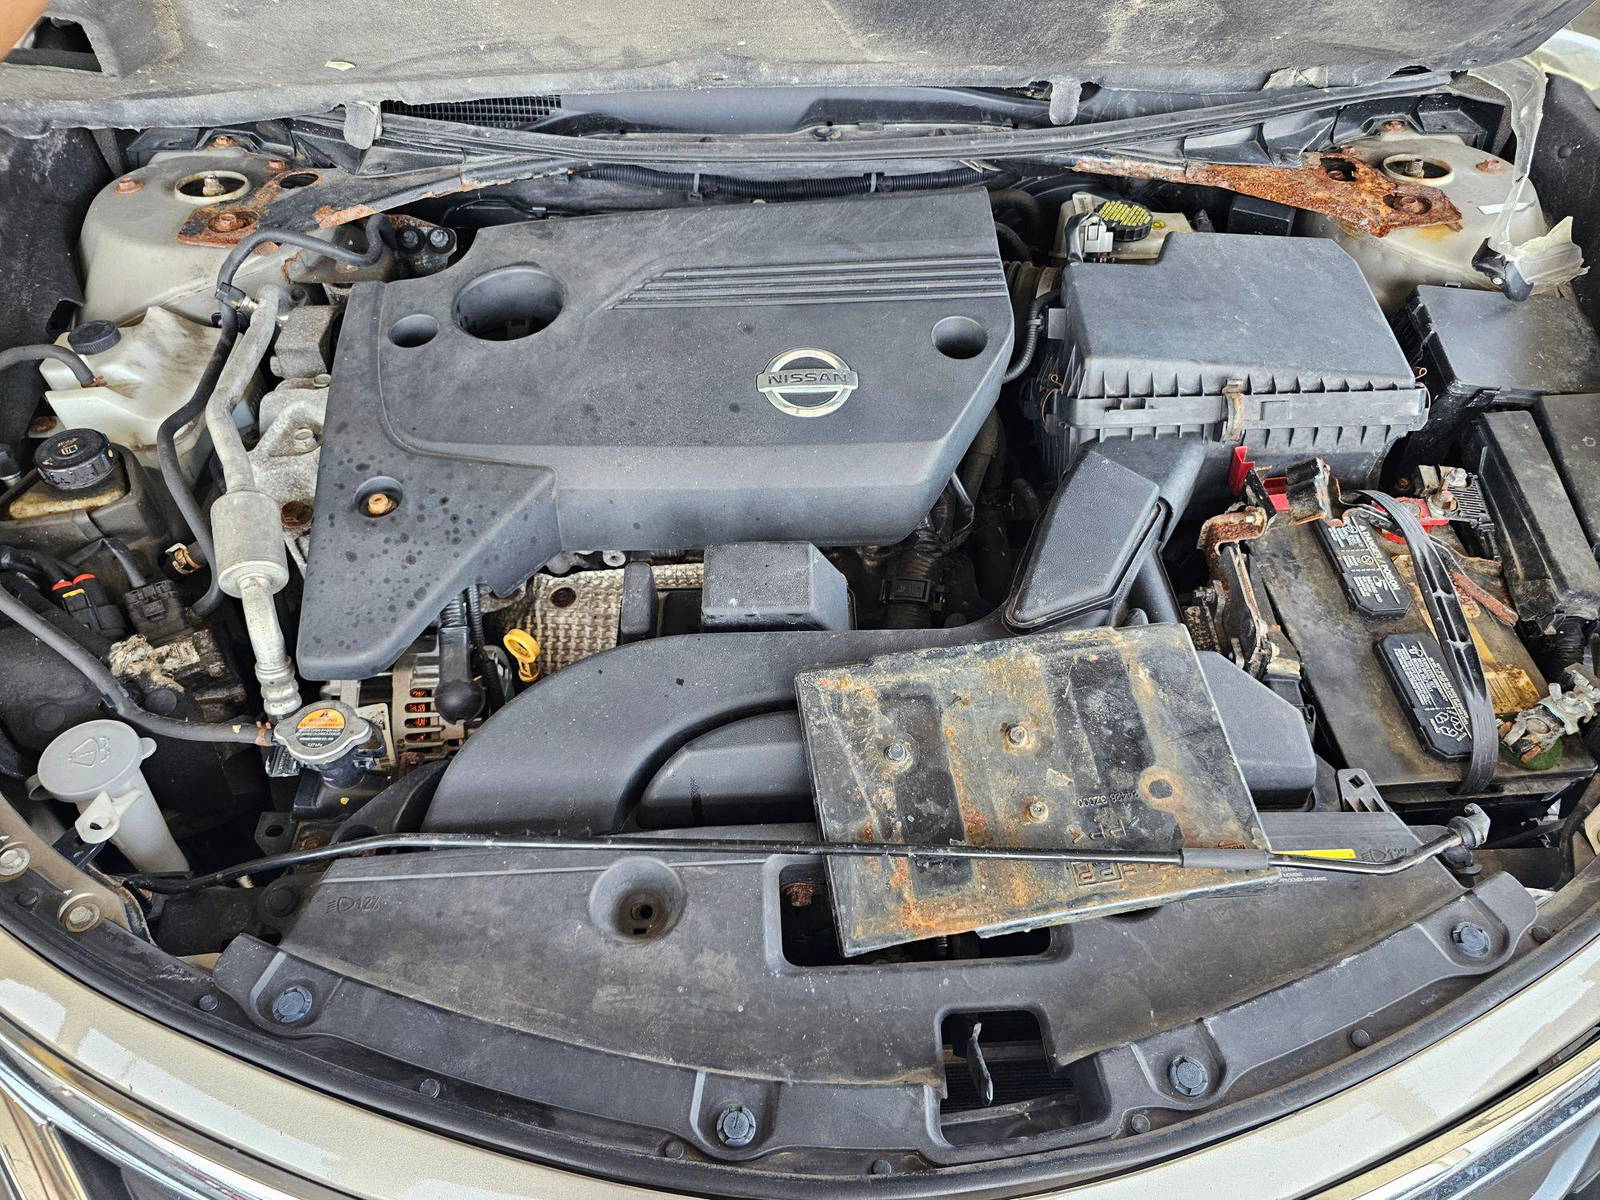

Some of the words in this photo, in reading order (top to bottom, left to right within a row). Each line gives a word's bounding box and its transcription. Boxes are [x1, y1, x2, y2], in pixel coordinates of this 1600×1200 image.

[768, 373, 847, 384] NISSAN
[1363, 531, 1381, 558] DANGER
[1381, 565, 1400, 591] POISON
